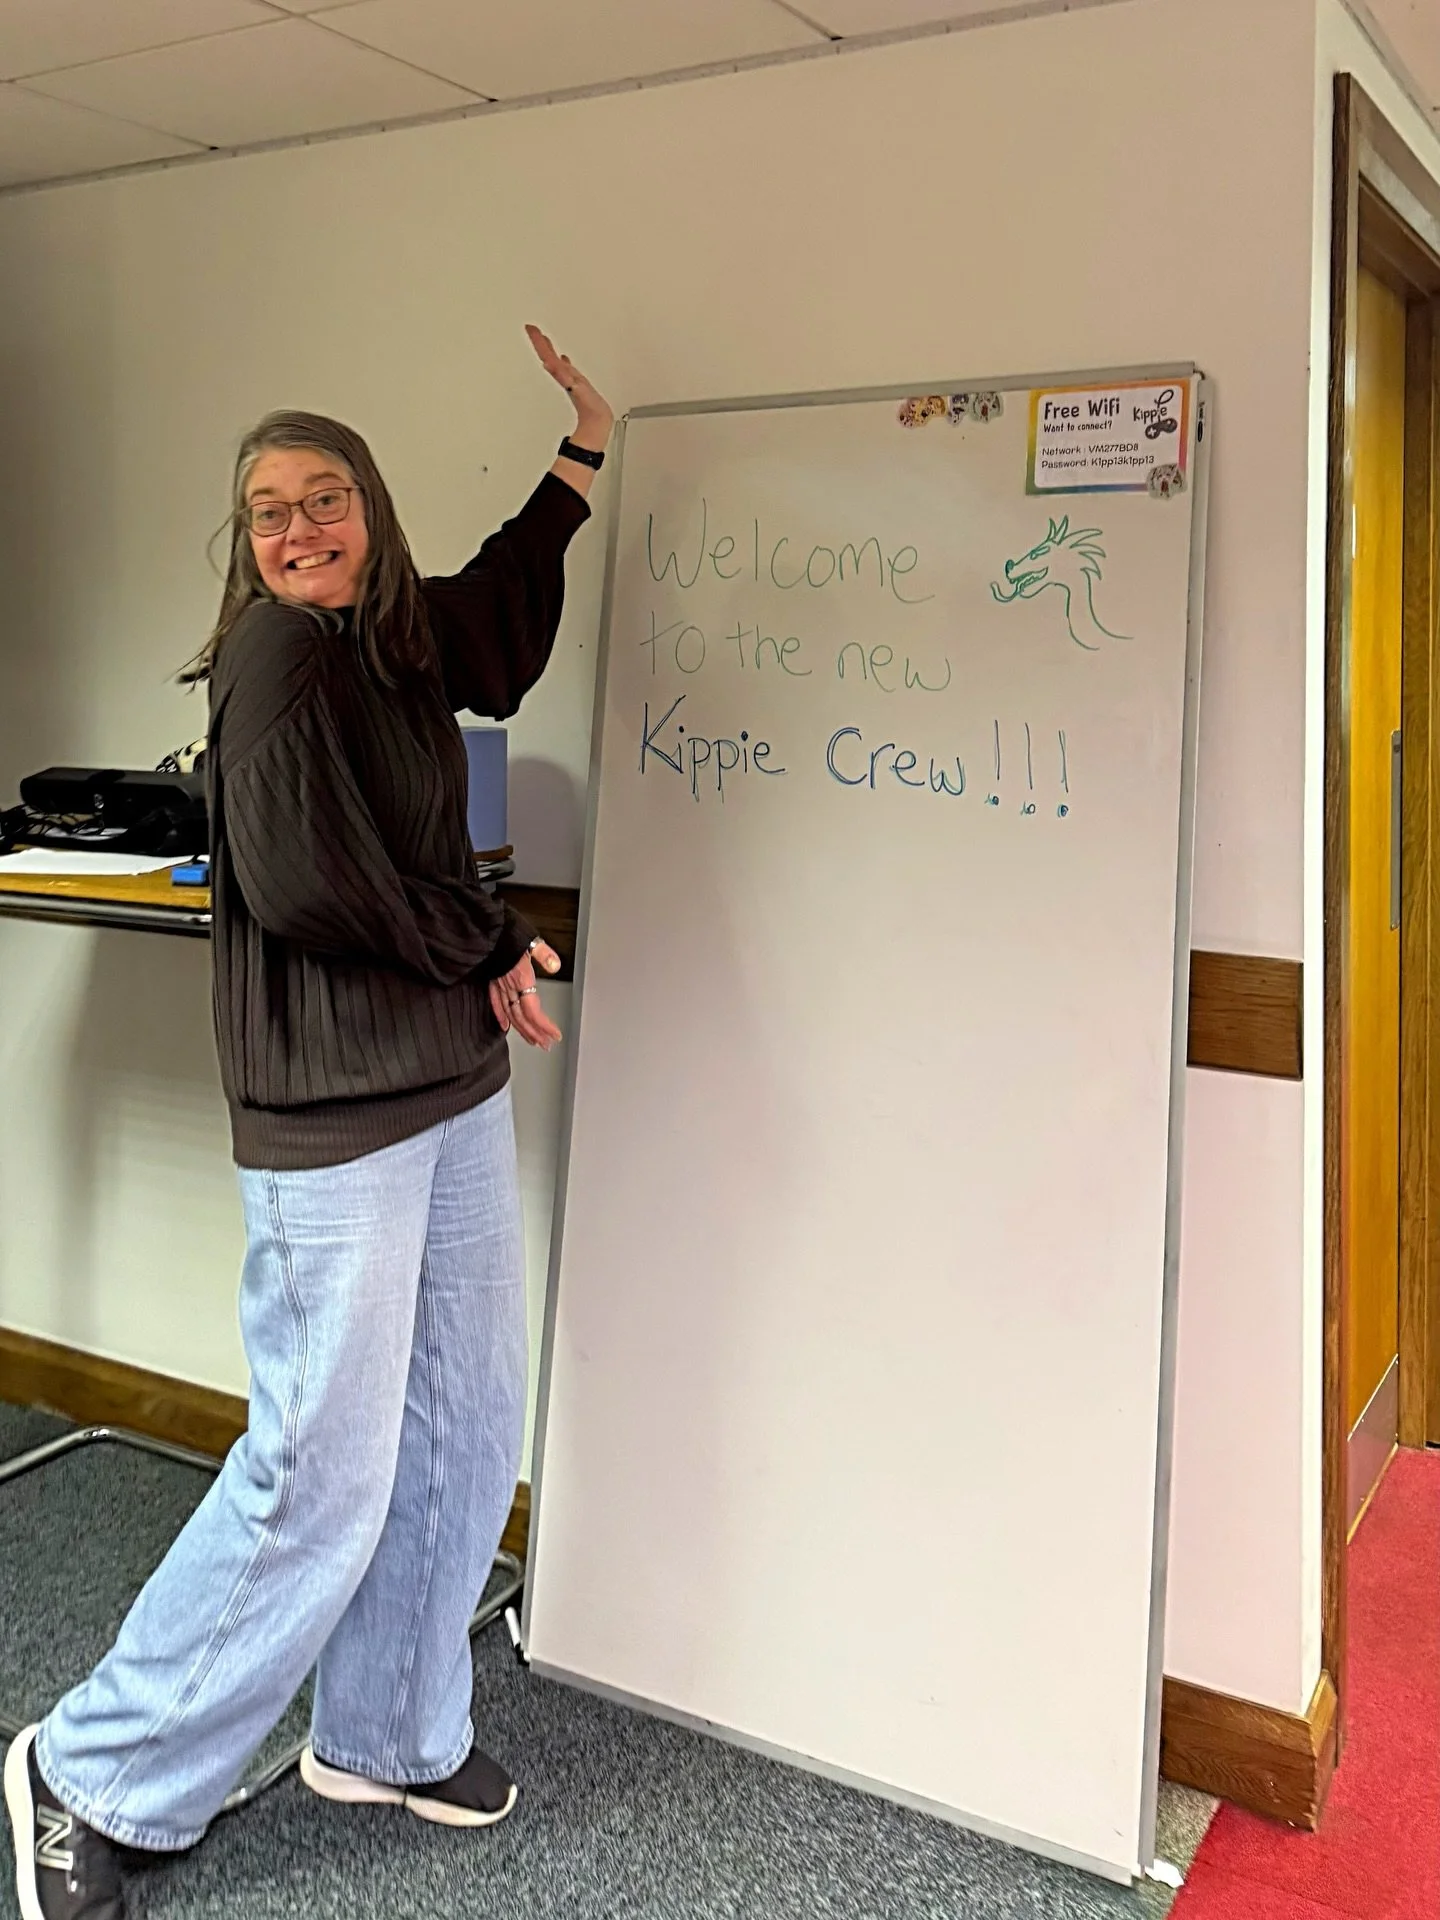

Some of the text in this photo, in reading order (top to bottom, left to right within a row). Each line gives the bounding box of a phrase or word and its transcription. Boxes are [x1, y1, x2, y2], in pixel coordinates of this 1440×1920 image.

[1044, 402, 1080, 420] Free
[1043, 420, 1113, 433] Want to connect?
[1042, 445, 1081, 456] Network
[1041, 459, 1089, 469] Password:
[648, 498, 935, 603] Welcome
[640, 610, 951, 693] to the new
[639, 694, 788, 804] Kippie
